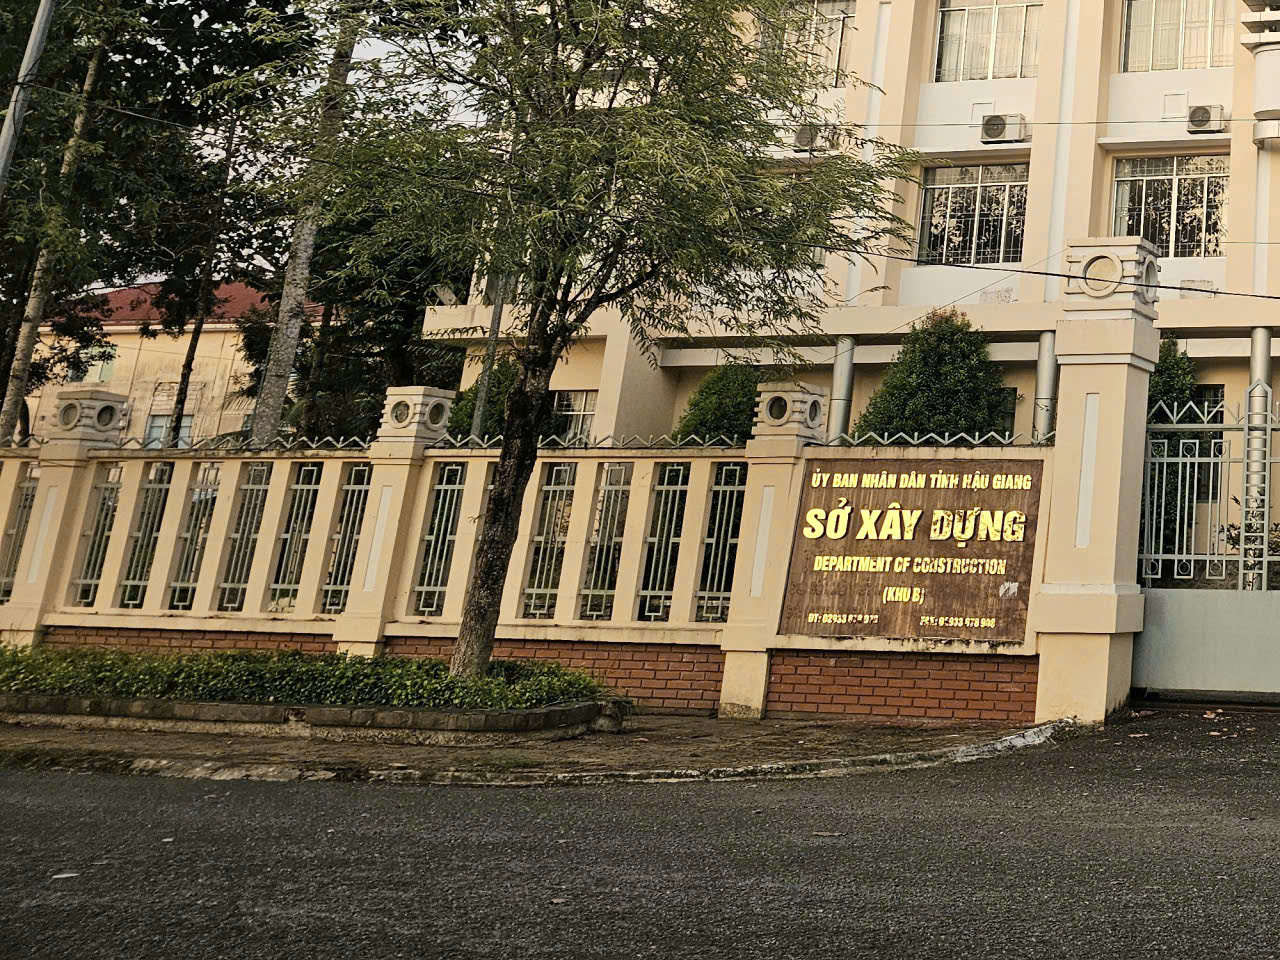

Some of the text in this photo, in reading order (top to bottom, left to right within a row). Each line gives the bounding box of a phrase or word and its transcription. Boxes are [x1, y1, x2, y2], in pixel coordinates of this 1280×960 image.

[811, 467, 1032, 492] ỦY BAN NHÂN DÂN TỈNH HẬU GIANG
[802, 497, 1027, 548] SỞ XÂY DỰNG
[813, 555, 1007, 575] DEPARTMENT OF CONSTRUCTION
[882, 586, 911, 604] (KHU
